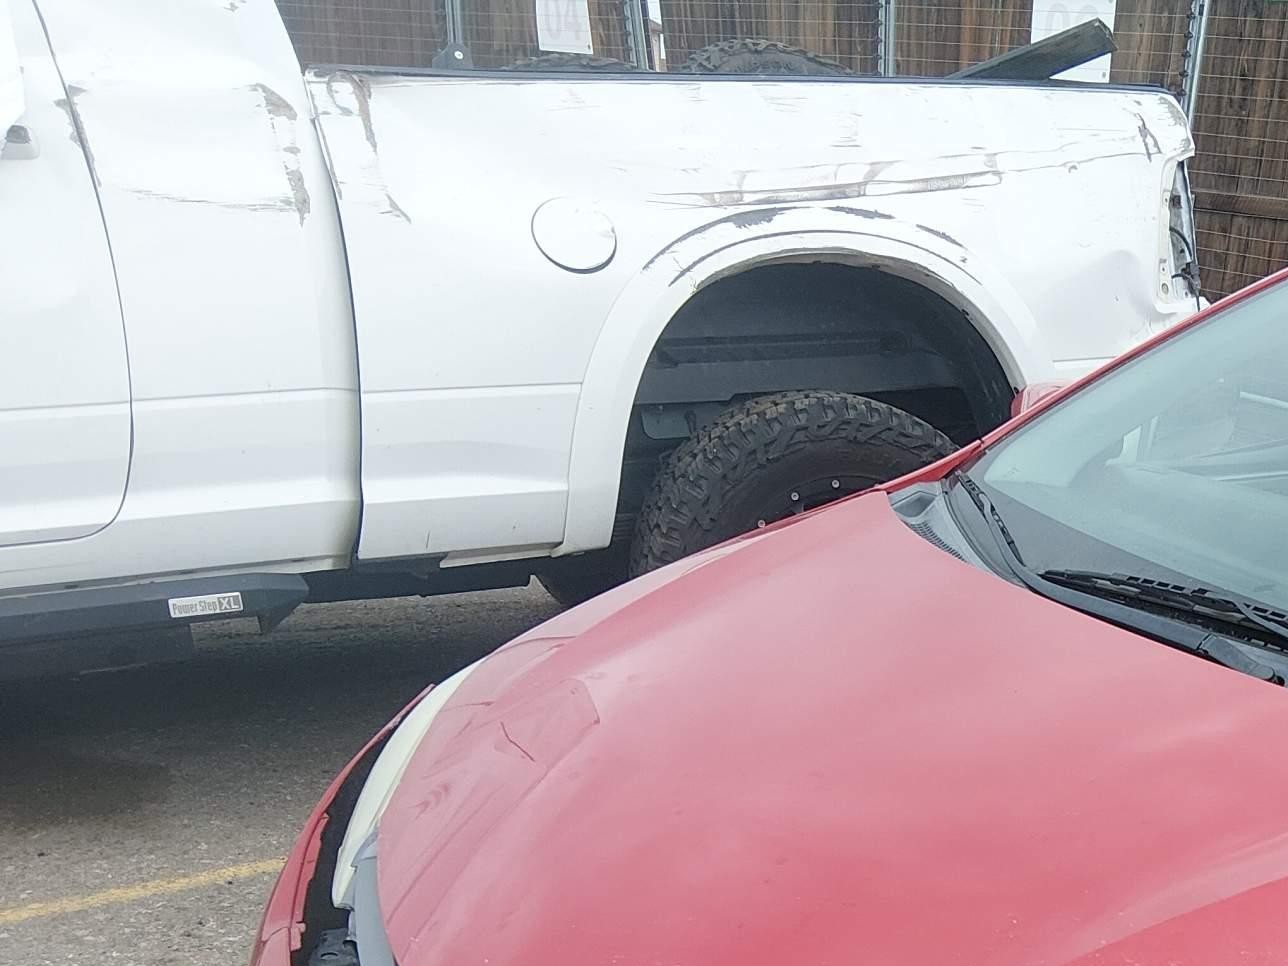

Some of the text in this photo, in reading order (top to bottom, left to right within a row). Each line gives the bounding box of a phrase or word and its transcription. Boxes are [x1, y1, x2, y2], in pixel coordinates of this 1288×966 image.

[172, 596, 240, 615] Power Step XL
